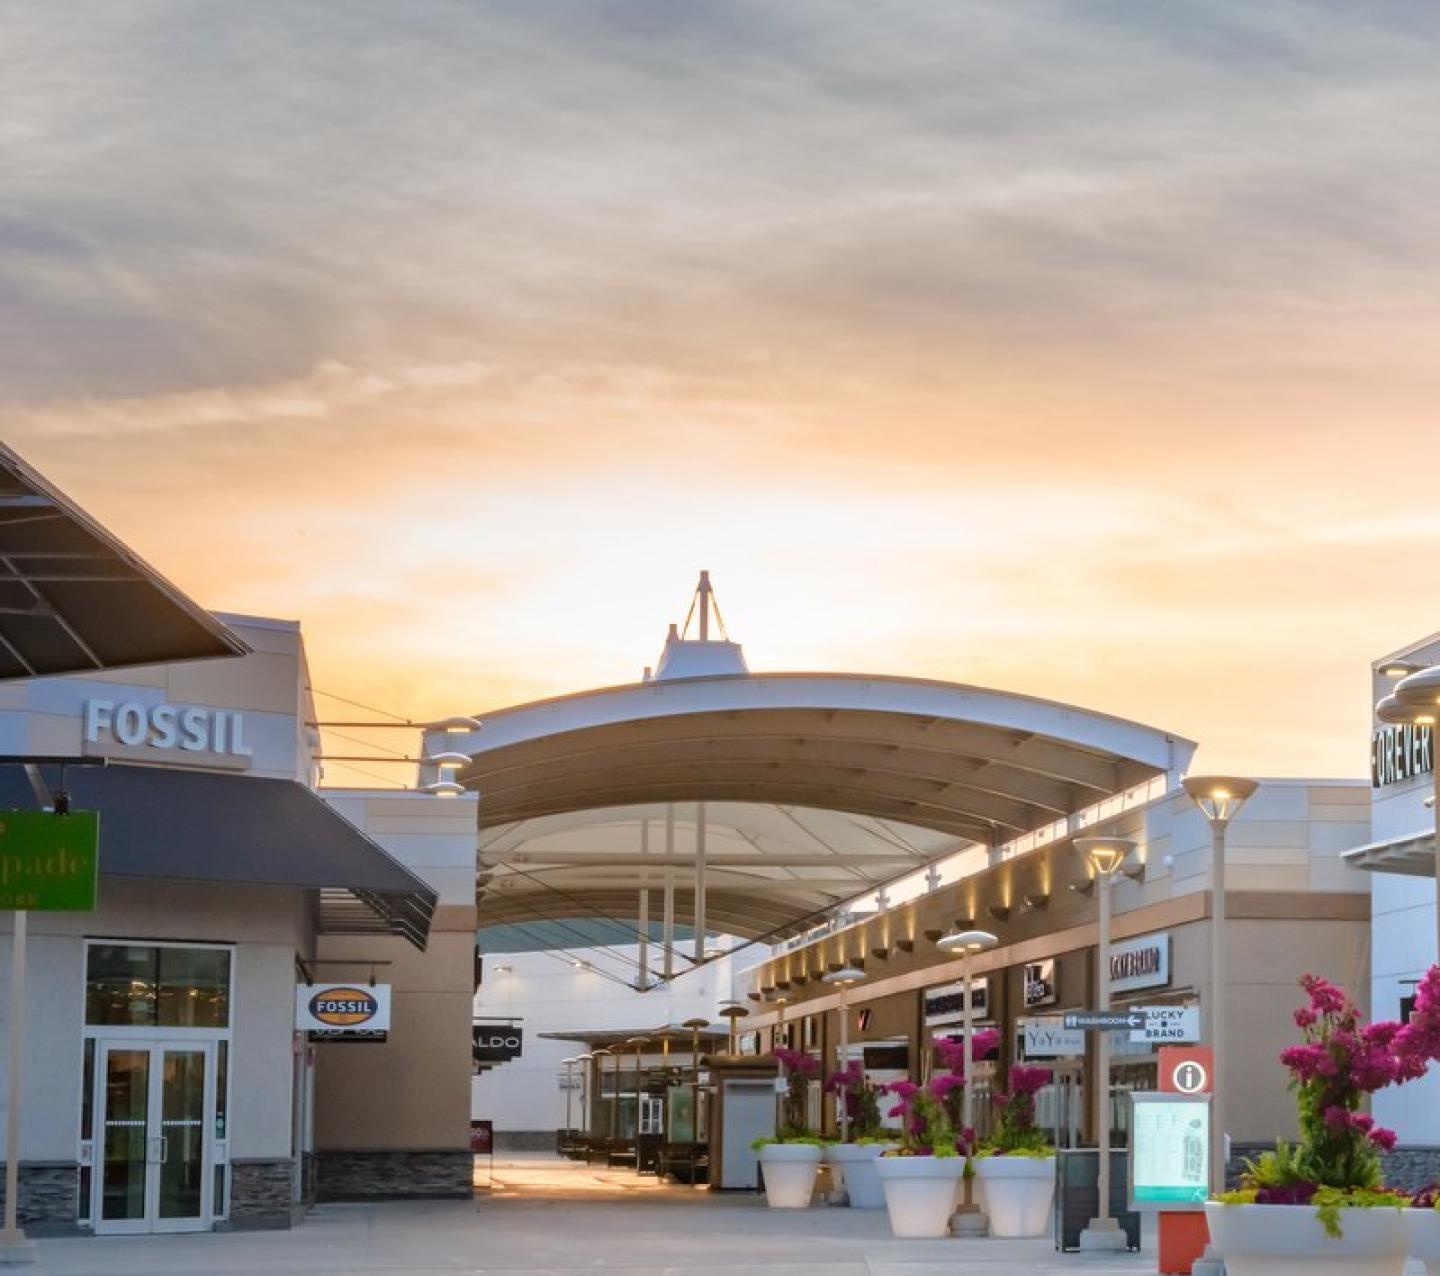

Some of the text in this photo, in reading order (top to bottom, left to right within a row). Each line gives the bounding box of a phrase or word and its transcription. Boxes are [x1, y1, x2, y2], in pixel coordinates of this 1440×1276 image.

[86, 698, 253, 756] FOSSIL
[0, 848, 89, 886] pade
[316, 1001, 372, 1012] FOSSIL
[1146, 1029, 1184, 1037] BRAND
